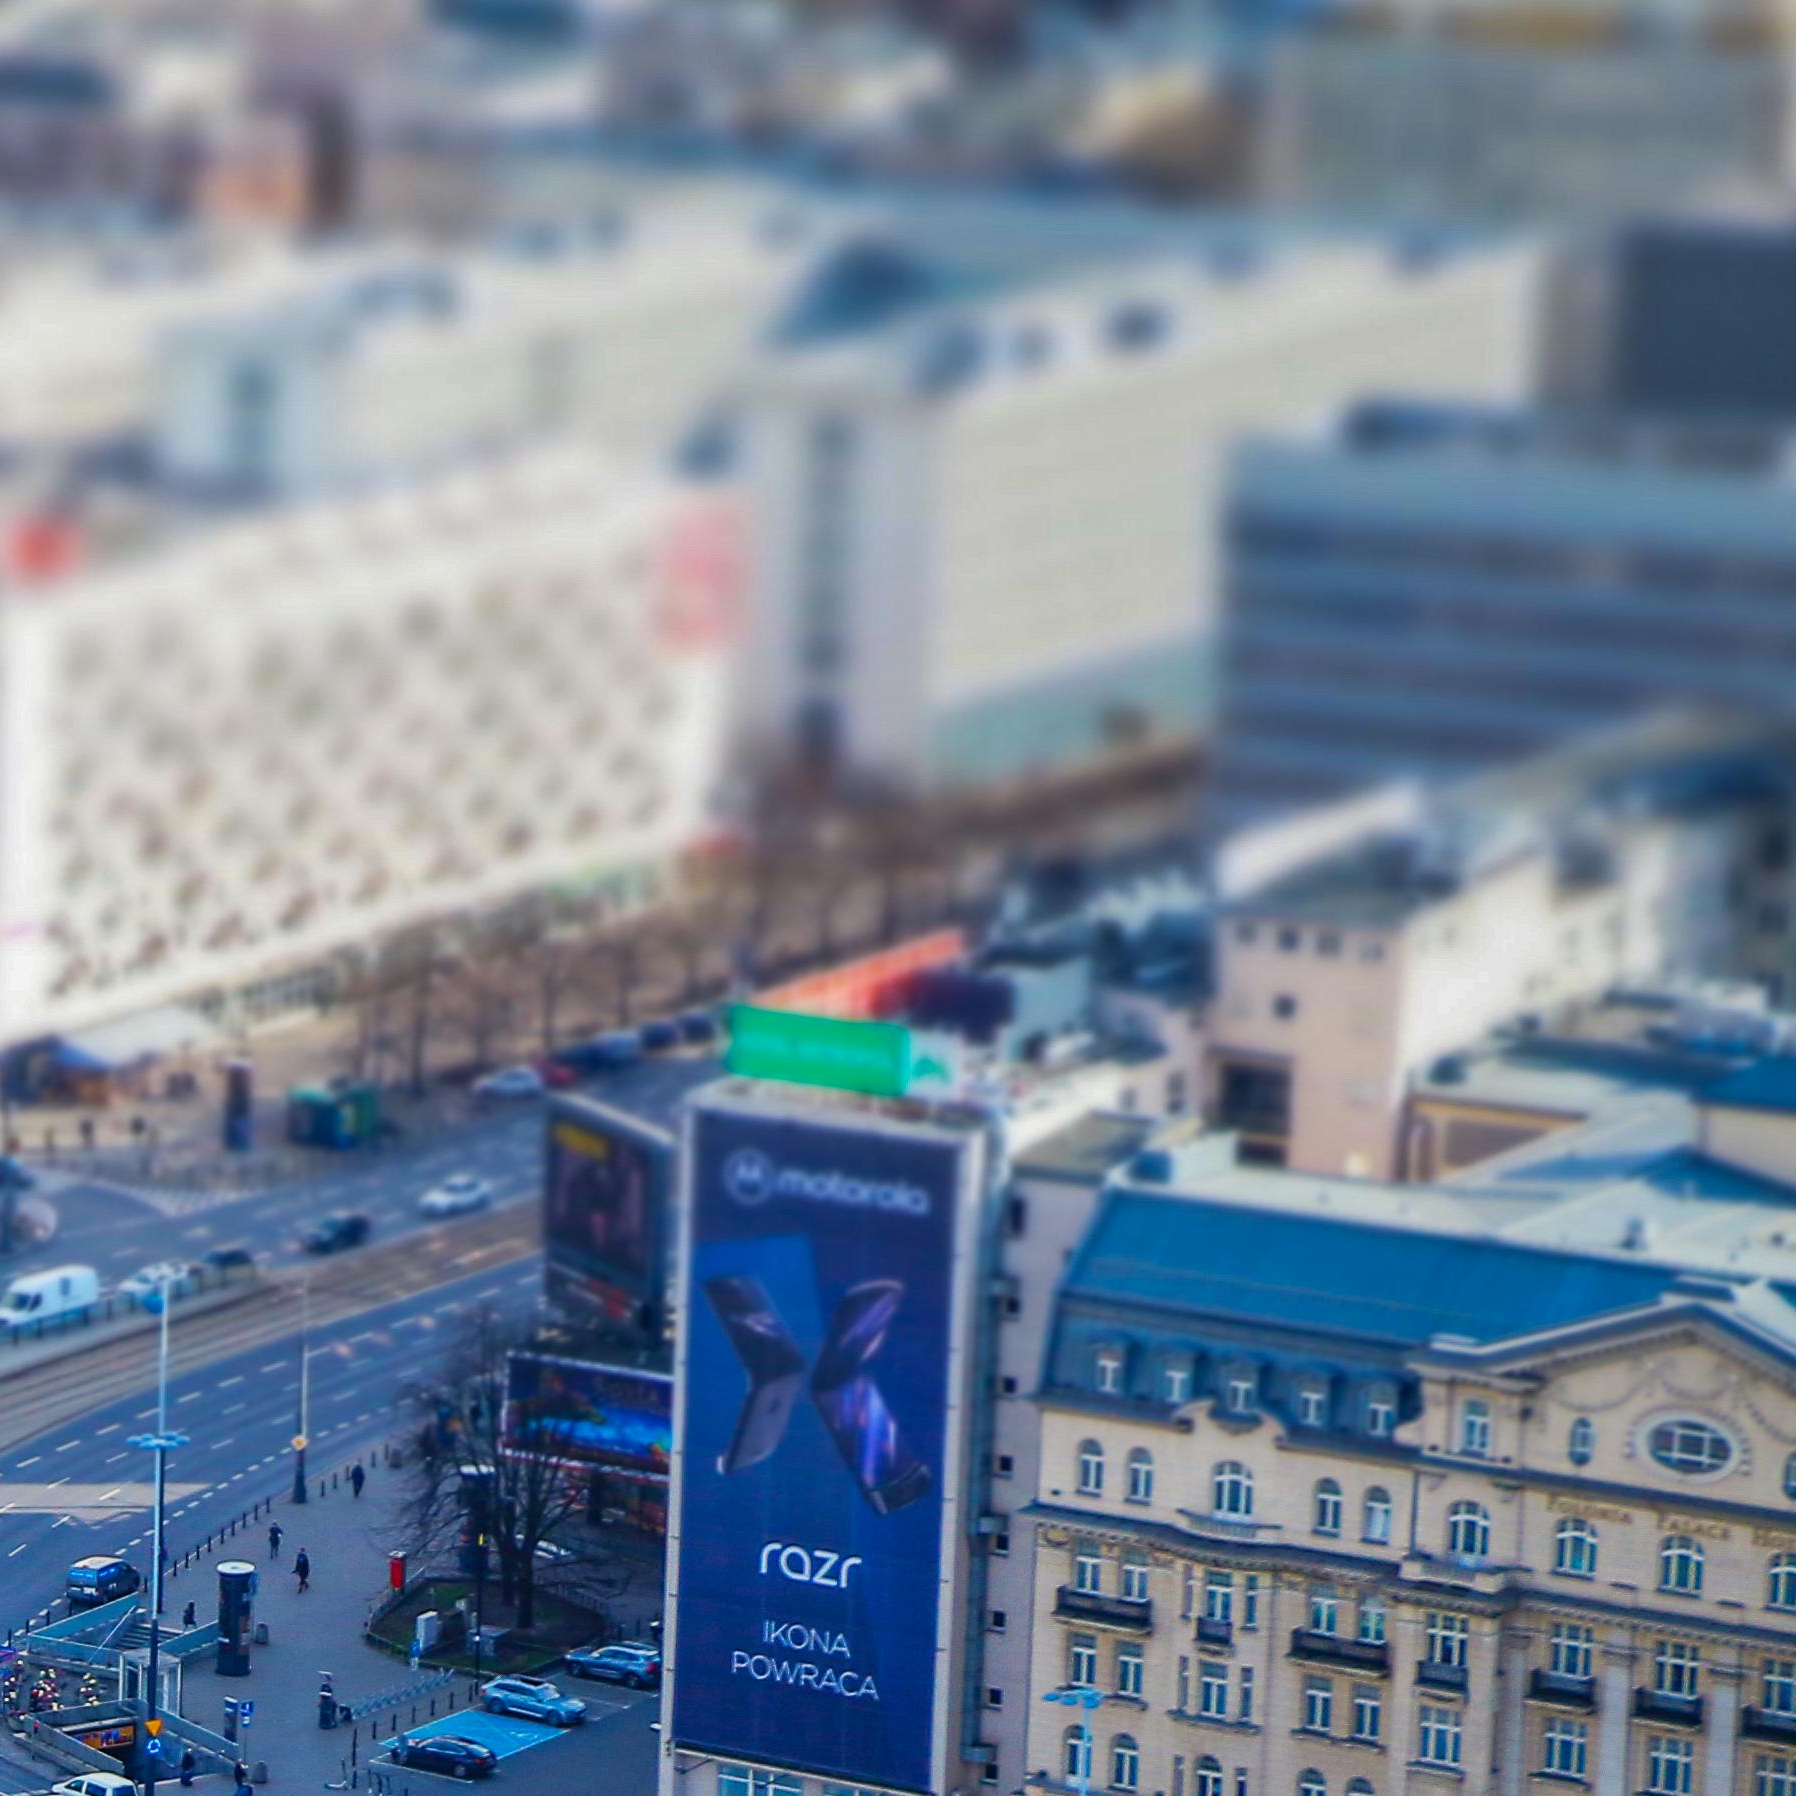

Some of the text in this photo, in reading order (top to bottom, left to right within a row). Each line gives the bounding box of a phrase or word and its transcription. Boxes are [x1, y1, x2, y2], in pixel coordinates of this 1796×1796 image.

[777, 1170, 930, 1216] motorola
[760, 1542, 862, 1588] razr
[763, 1620, 851, 1659] IKONA
[732, 1651, 880, 1701] POWRACA
